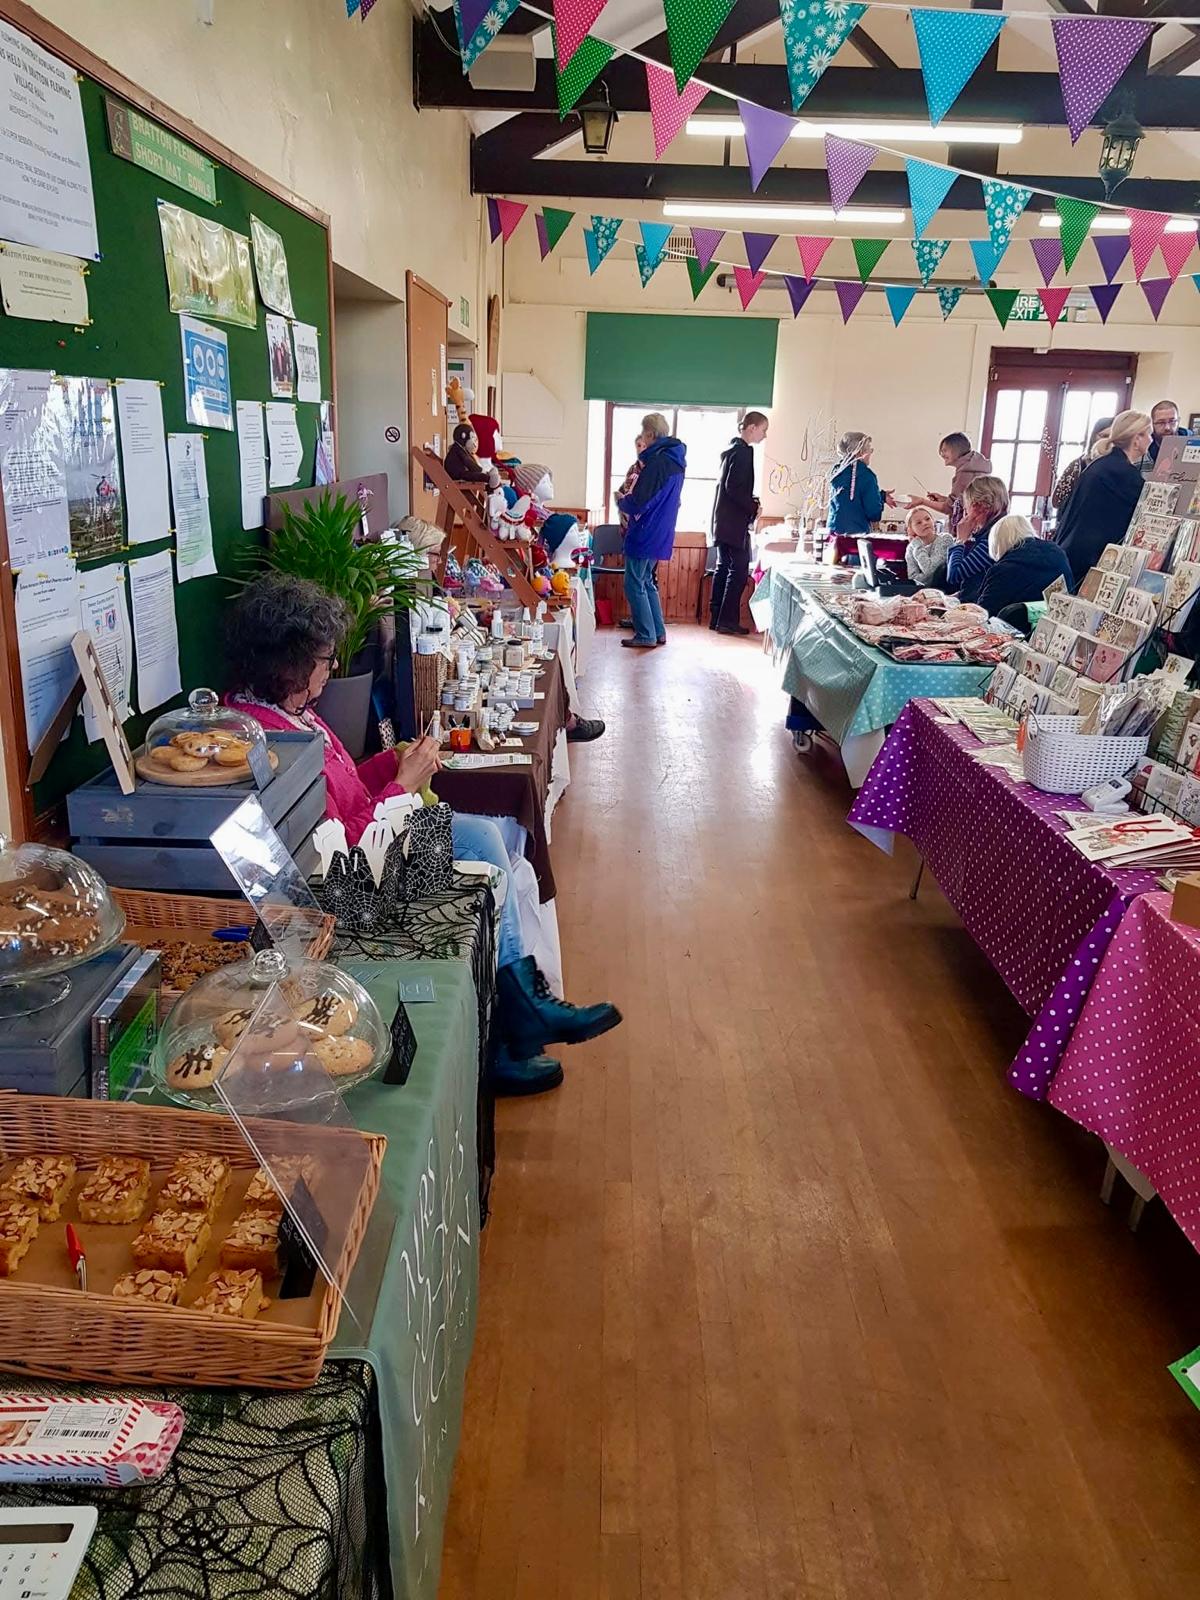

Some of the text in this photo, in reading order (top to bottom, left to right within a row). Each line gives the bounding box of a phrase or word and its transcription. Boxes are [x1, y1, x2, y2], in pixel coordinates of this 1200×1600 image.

[13, 72, 34, 94] VILLAGE
[132, 112, 172, 153] BRATTON
[135, 141, 163, 168] SHORT
[166, 158, 182, 181] MAT
[1015, 296, 1038, 308] IRE
[1008, 308, 1036, 320] EXIT
[36, 1475, 103, 1484] Wax paper
